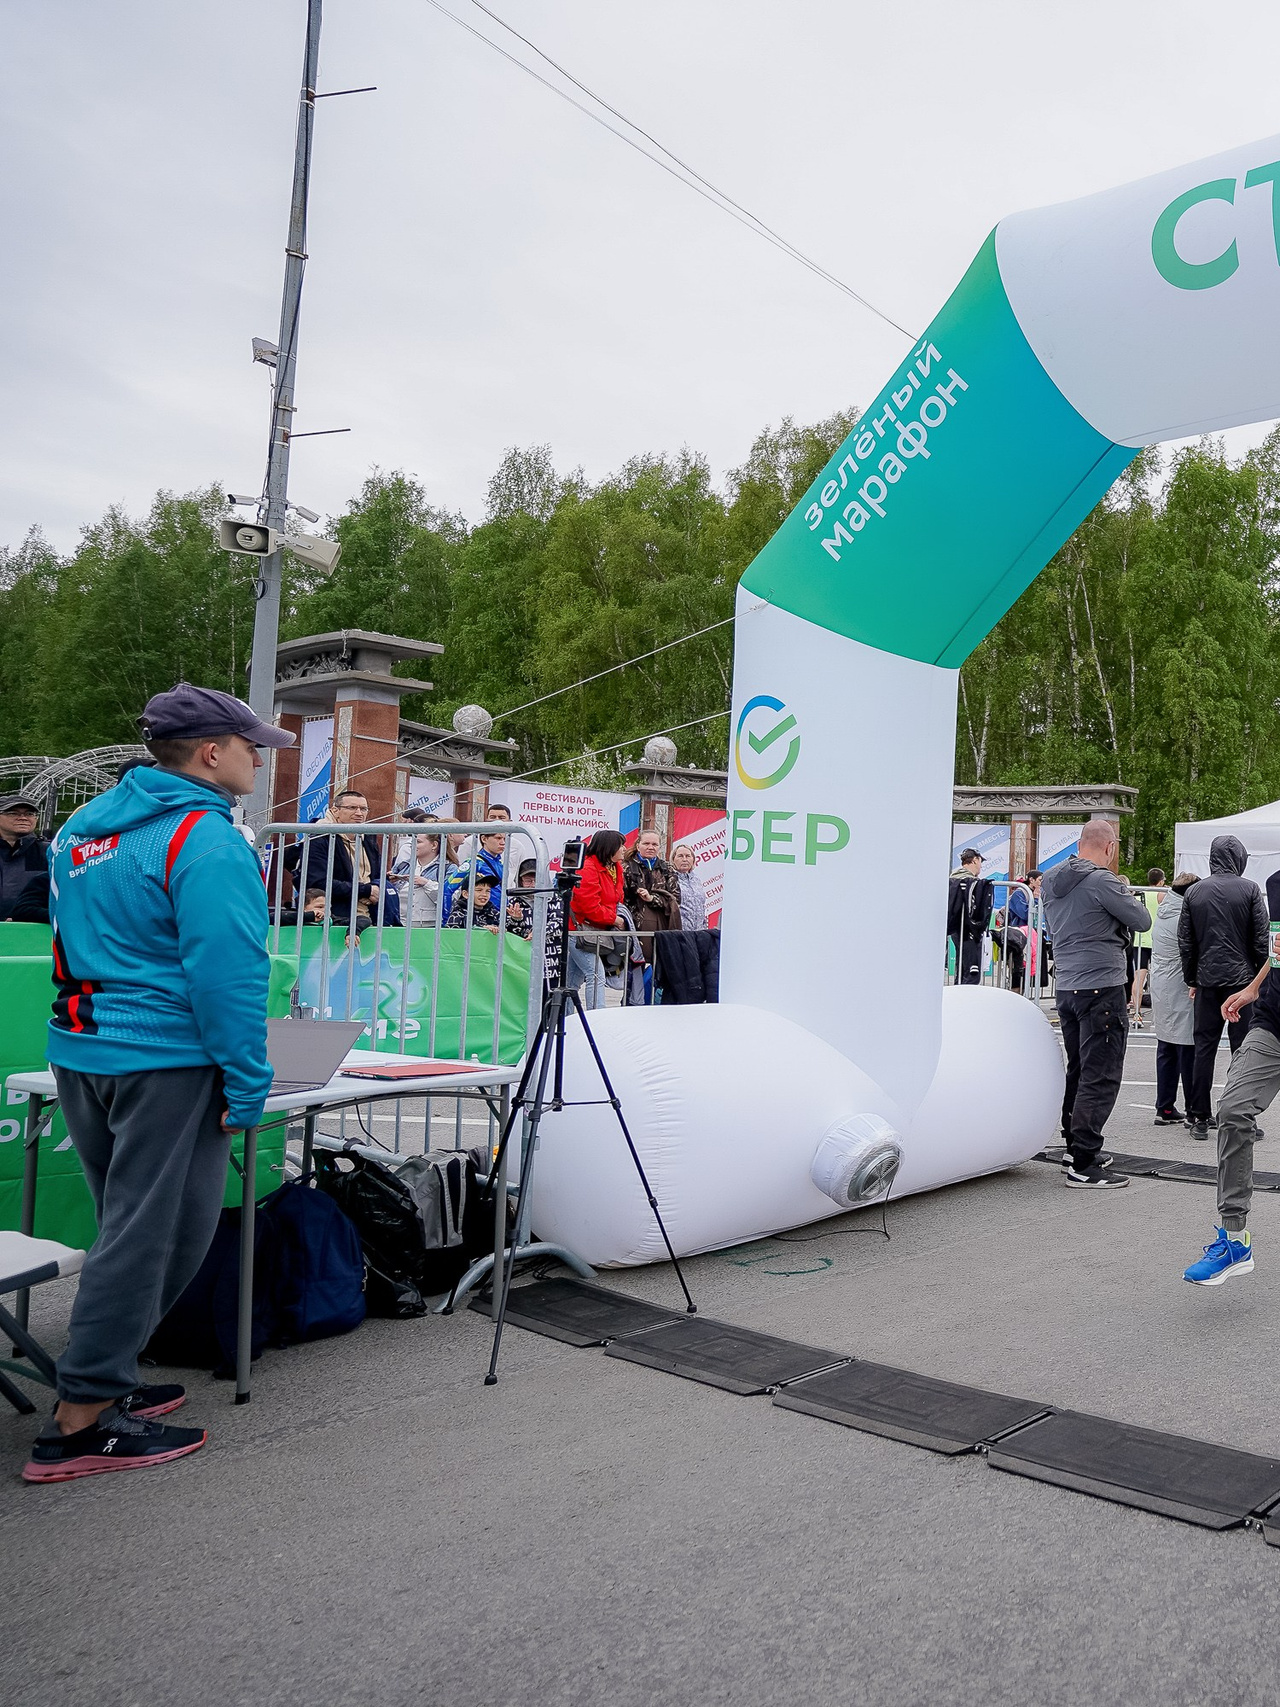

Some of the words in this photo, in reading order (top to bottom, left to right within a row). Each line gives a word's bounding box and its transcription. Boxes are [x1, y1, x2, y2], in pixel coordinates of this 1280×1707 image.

[803, 339, 943, 531] зелёный
[820, 367, 970, 562] марафон
[523, 802, 564, 814] ПЕРВЫХ
[577, 808, 606, 817] ЮГРЕ.
[536, 791, 595, 805] ФЕСТИВАЛЬ
[519, 814, 610, 829] ХАНТЫ-МАНСИЙСК
[725, 809, 850, 866] БЕР
[977, 829, 1006, 848] ВМЕСТЕ
[1042, 830, 1080, 857] ФЕСТИВАЛЬ
